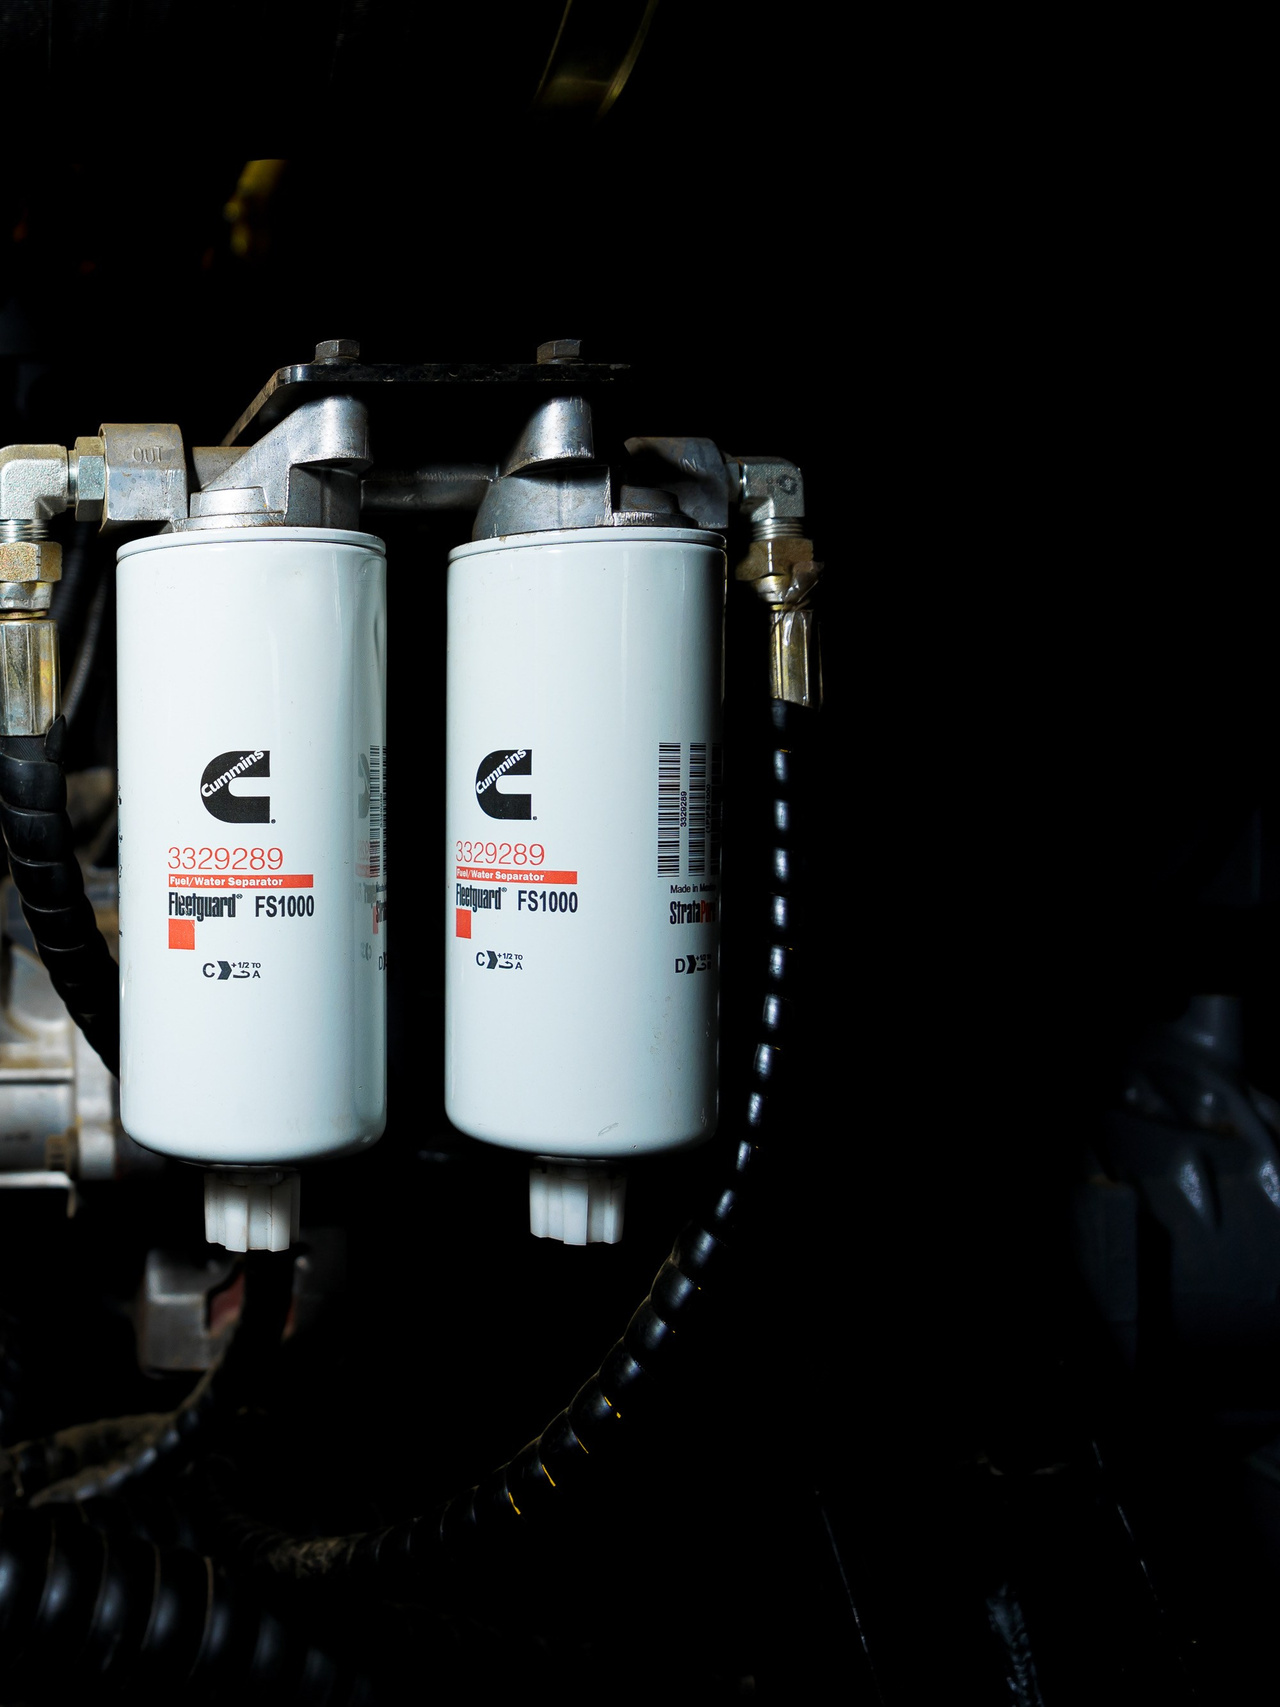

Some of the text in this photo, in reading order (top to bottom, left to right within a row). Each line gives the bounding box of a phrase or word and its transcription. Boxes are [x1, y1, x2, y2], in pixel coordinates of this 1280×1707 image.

[132, 445, 164, 464] OUT
[200, 749, 265, 798] Cummins
[475, 748, 527, 795] Cummins
[167, 846, 284, 870] 3329289
[455, 840, 546, 866] 3329289
[170, 876, 284, 888] Fuel/Water Separator
[456, 868, 545, 882] Fuel/Water Separator
[670, 884, 691, 893] Made
[692, 883, 699, 892] in
[255, 895, 315, 917] FS1000
[517, 890, 579, 913] FS1000
[475, 951, 486, 967] C
[514, 953, 523, 961] TO
[515, 961, 523, 970] A
[202, 962, 216, 978] C
[252, 970, 261, 978] A
